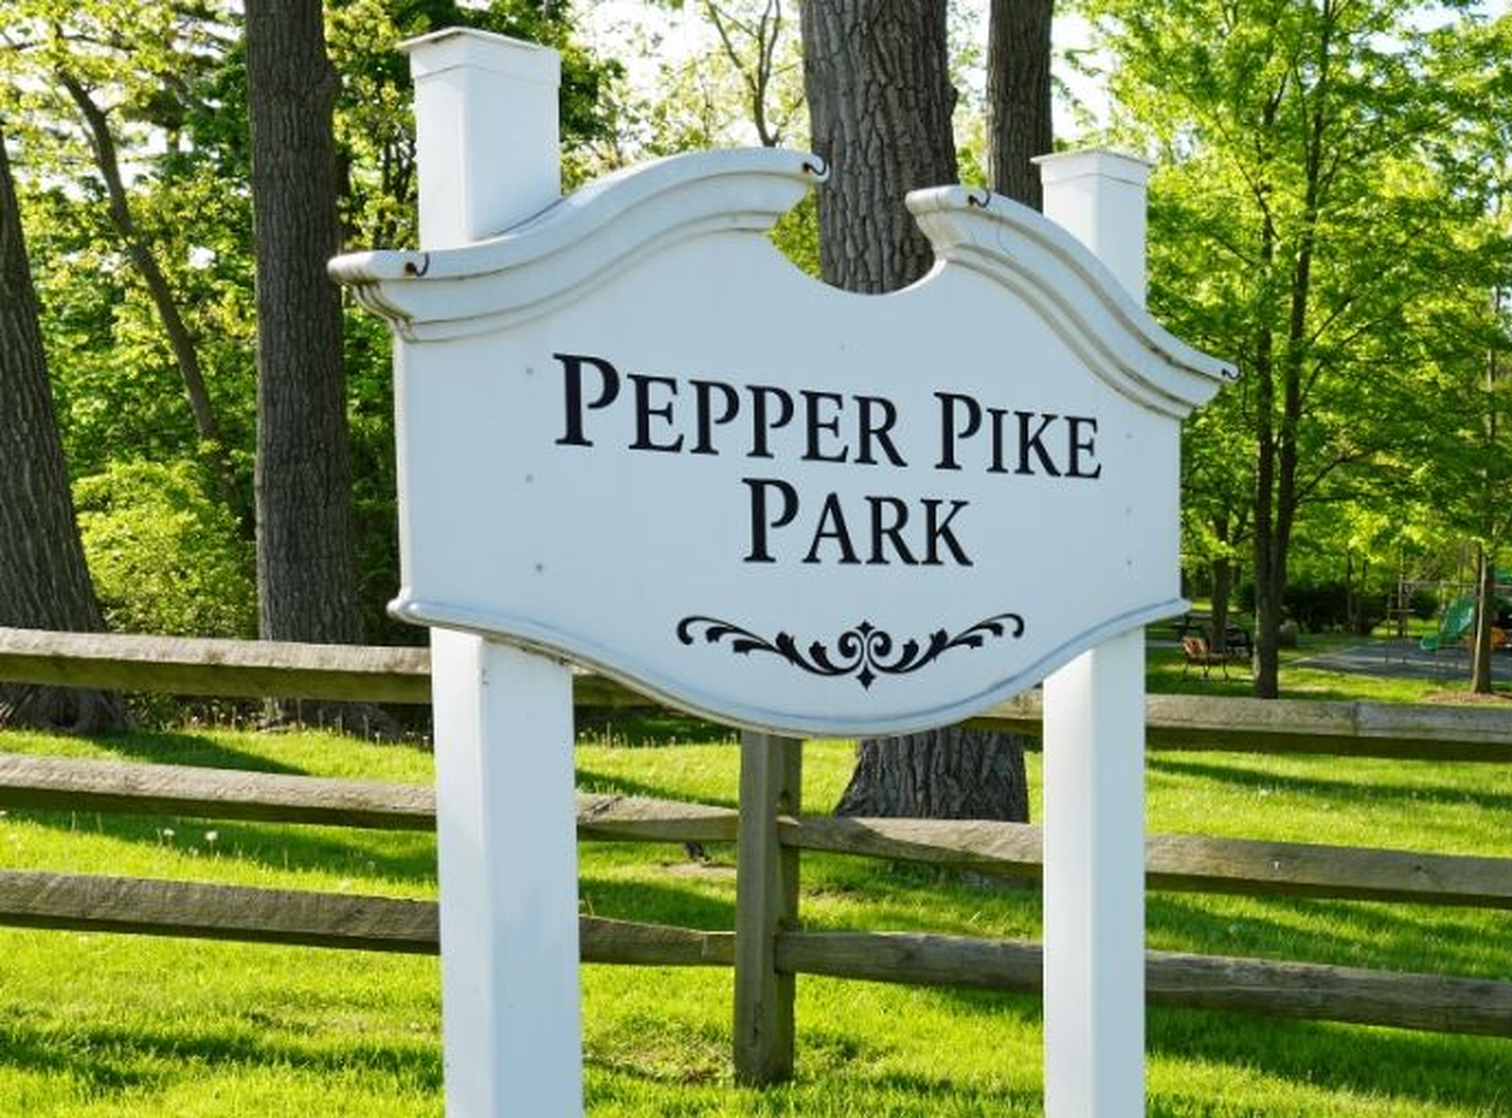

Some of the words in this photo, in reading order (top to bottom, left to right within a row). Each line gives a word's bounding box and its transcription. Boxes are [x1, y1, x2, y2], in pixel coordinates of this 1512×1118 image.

[553, 353, 908, 468] PEPPER
[933, 391, 1103, 480] PIKE
[741, 477, 974, 567] PARK
